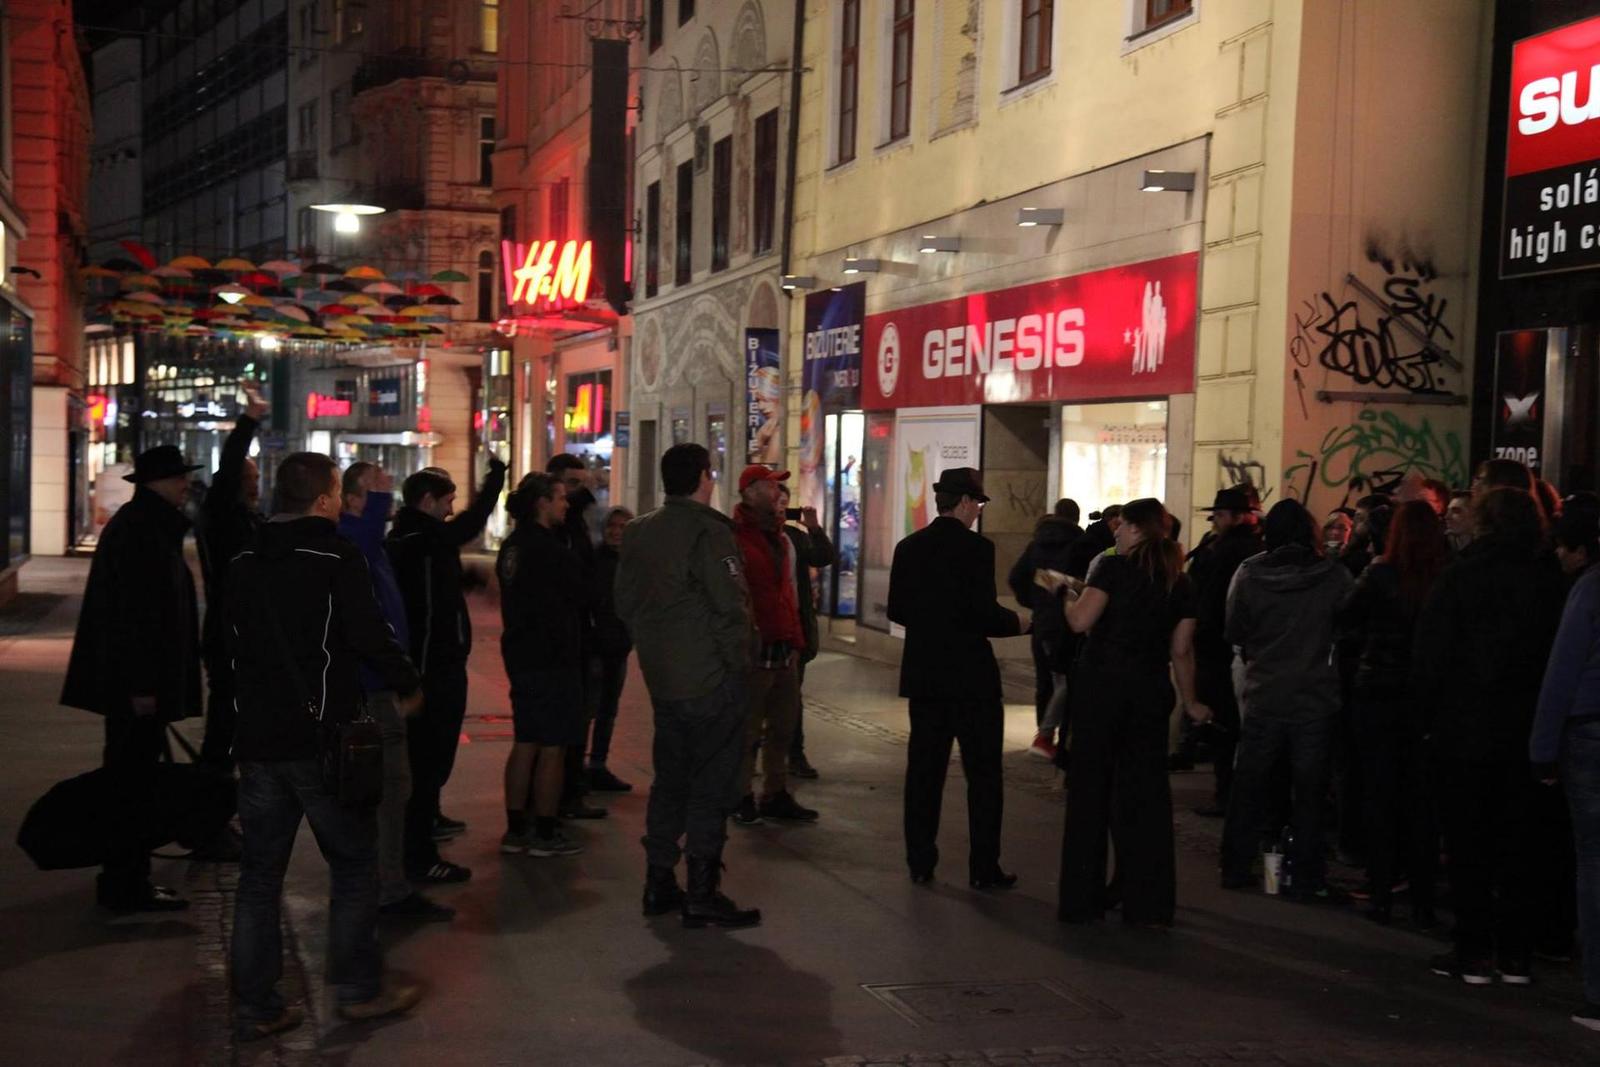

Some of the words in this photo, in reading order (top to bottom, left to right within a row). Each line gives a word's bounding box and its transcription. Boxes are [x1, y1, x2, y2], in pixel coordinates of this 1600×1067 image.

[1509, 220, 1568, 264] high
[1579, 223, 1600, 250] c
[512, 240, 592, 305] H&M
[884, 346, 895, 373] G
[922, 307, 1086, 380] GENESIS
